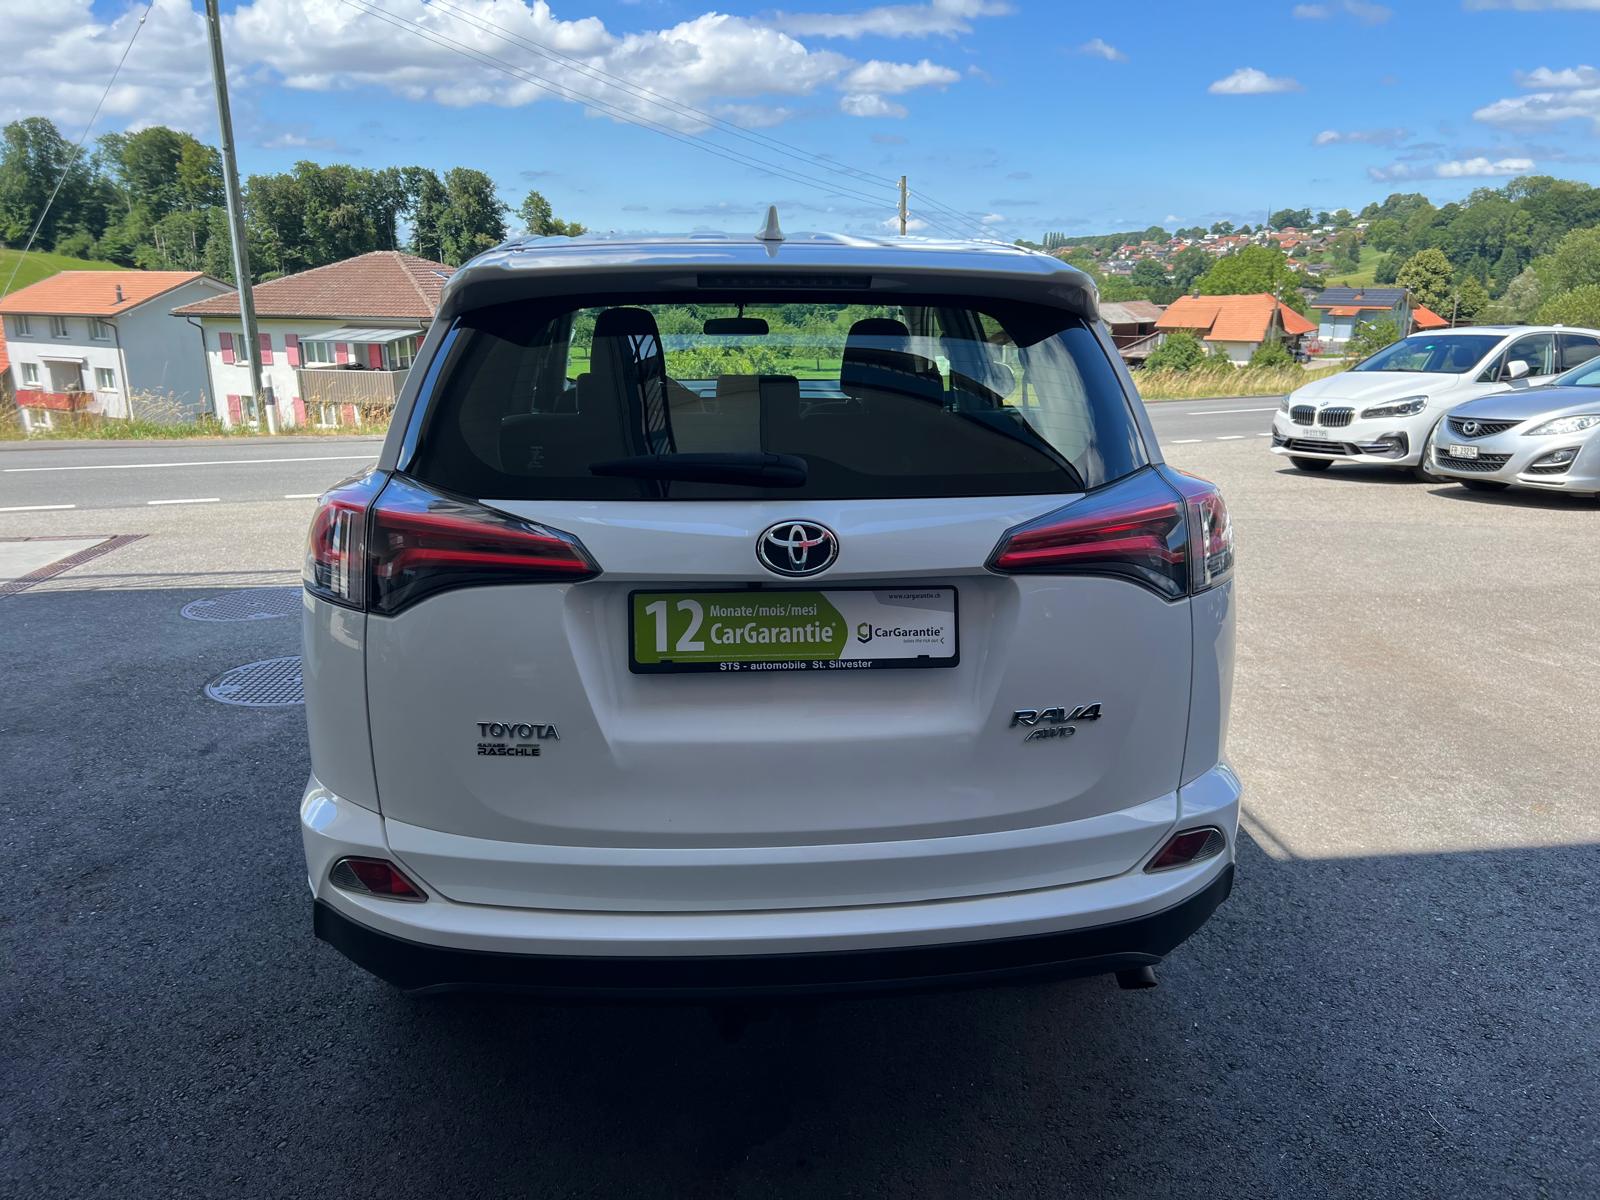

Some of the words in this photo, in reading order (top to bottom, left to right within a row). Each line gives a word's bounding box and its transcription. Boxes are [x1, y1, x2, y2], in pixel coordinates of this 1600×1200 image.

[710, 603, 817, 617] Monate/mois/mesi
[645, 599, 705, 653] 12
[710, 621, 833, 645] CarGarantie
[874, 626, 941, 637] CarGarantie
[719, 662, 740, 671] STS
[750, 661, 807, 670] automobile
[812, 660, 826, 669] St.
[828, 660, 873, 669] Silvester
[1009, 702, 1103, 728] RAV4
[477, 721, 560, 740] TOYOTA
[1024, 725, 1076, 741] AWD
[477, 748, 541, 757] RASCHLE
